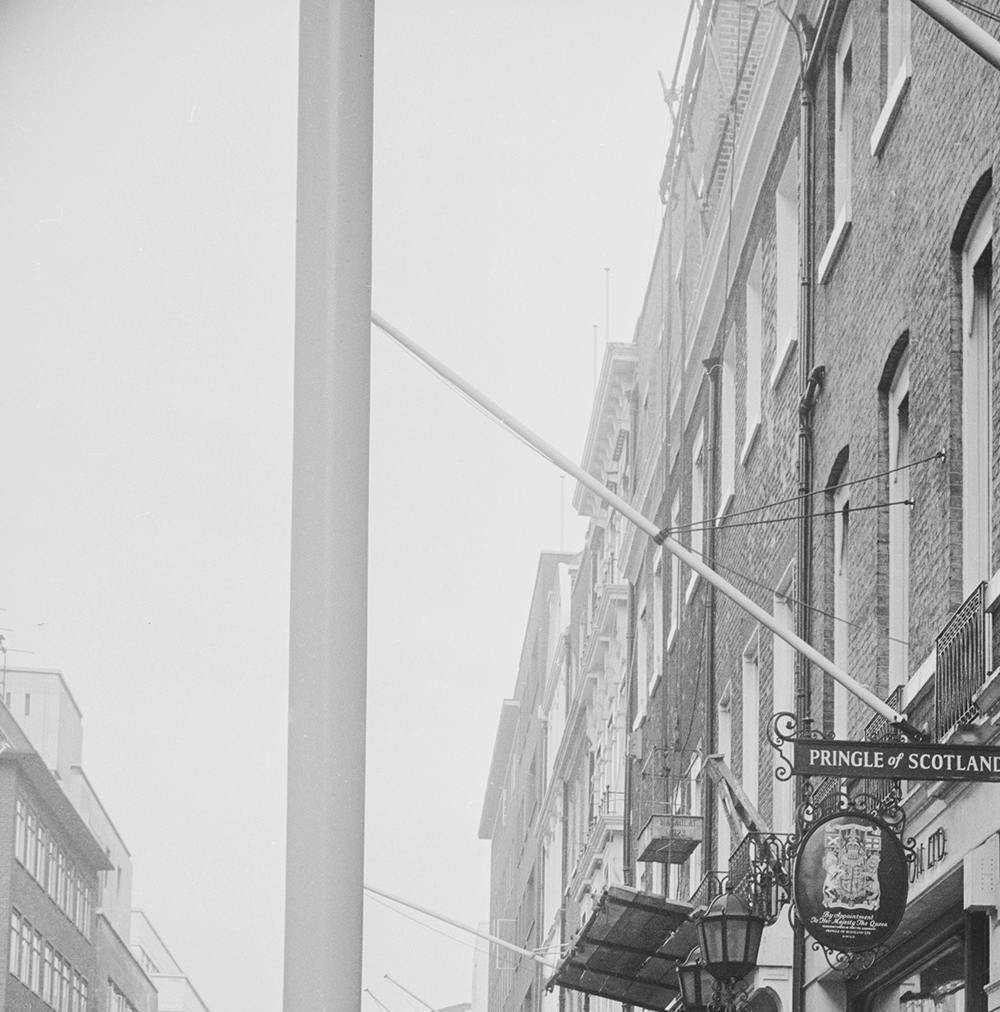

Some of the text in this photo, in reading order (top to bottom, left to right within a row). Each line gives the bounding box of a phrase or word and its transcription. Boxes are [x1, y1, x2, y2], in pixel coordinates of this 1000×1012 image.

[809, 749, 884, 768] PRINGLE
[887, 752, 904, 769] of
[834, 912, 874, 920] Appointment
[831, 919, 856, 928] Majesty
[869, 920, 888, 928] Queen
